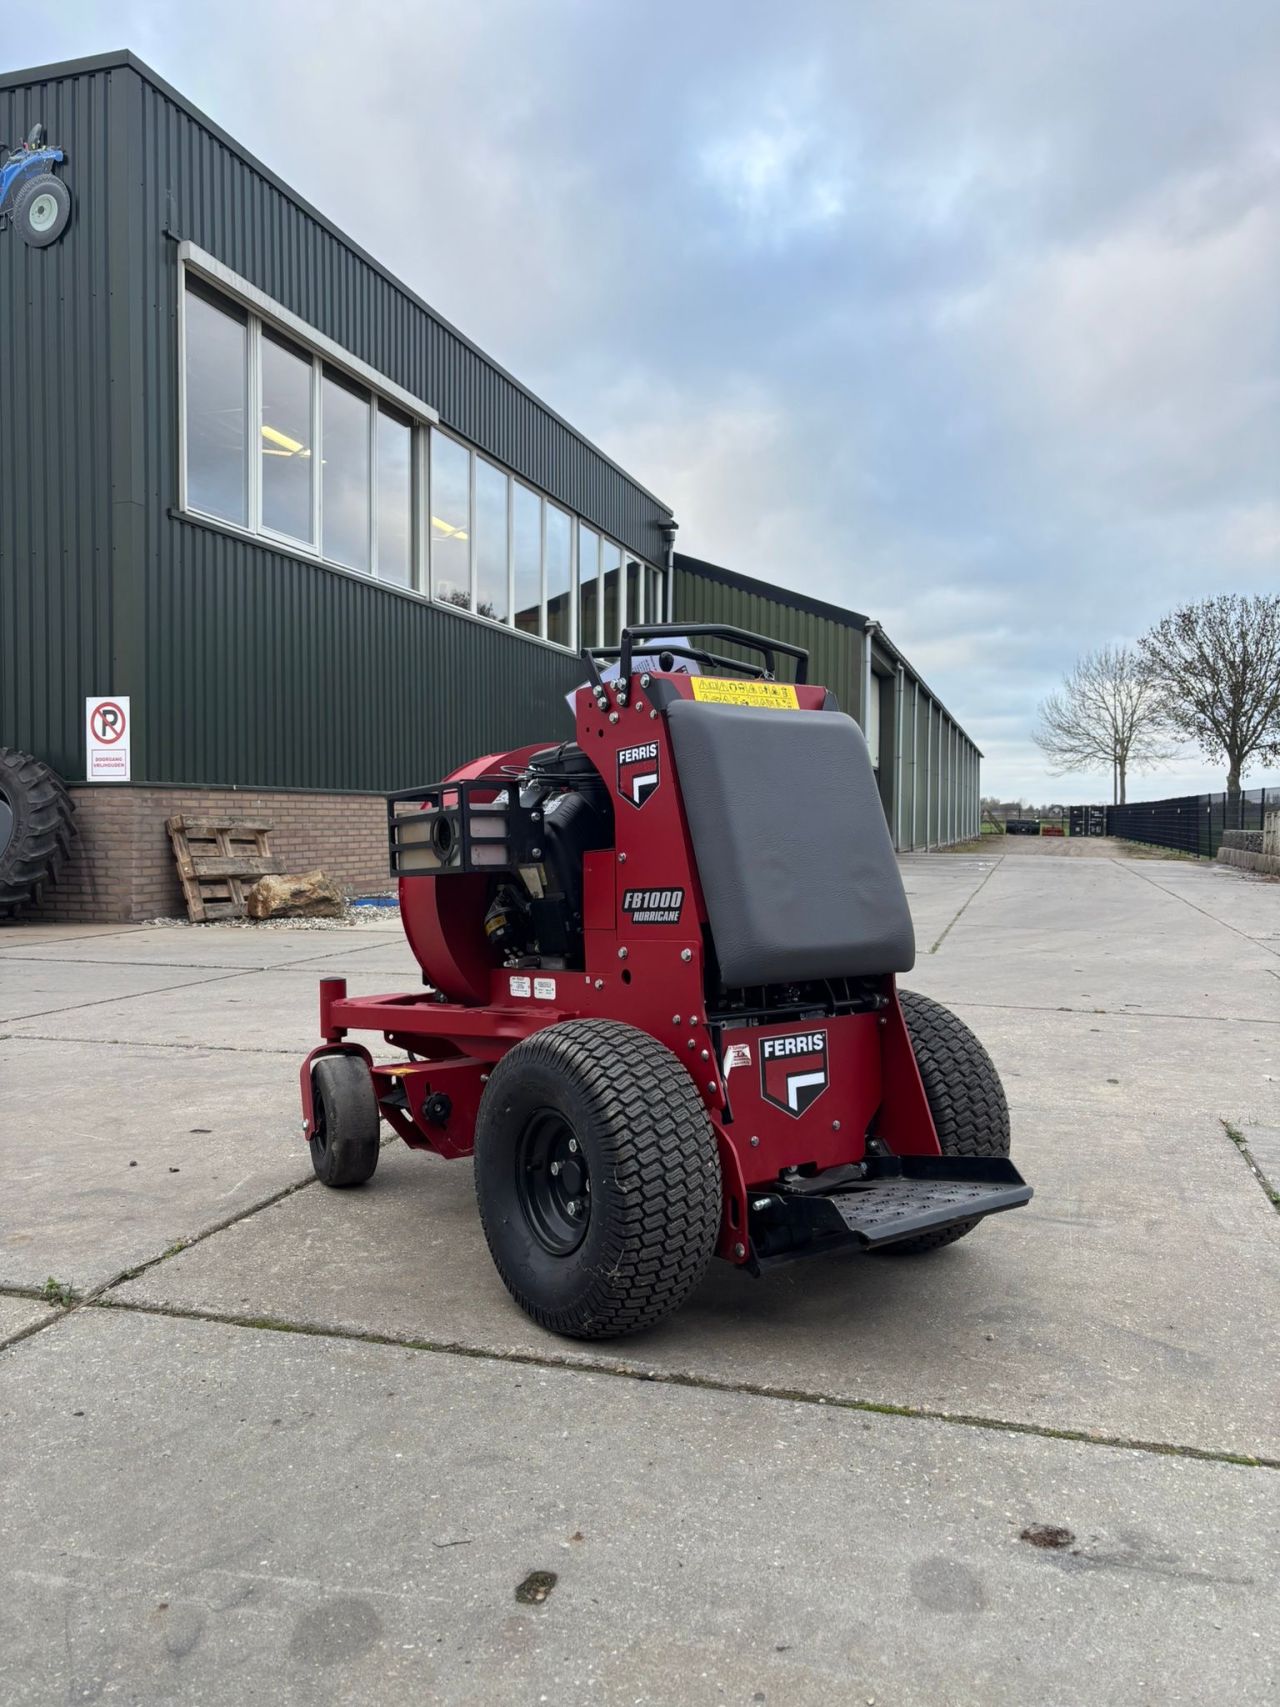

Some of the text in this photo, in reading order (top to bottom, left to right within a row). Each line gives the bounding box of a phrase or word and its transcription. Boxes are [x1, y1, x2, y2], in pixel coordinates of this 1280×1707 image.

[102, 709, 119, 737] P
[619, 743, 657, 764] FERRIS
[624, 891, 683, 909] FB1000
[633, 911, 680, 922] HURRICANE
[764, 1033, 824, 1058] FERRIS
